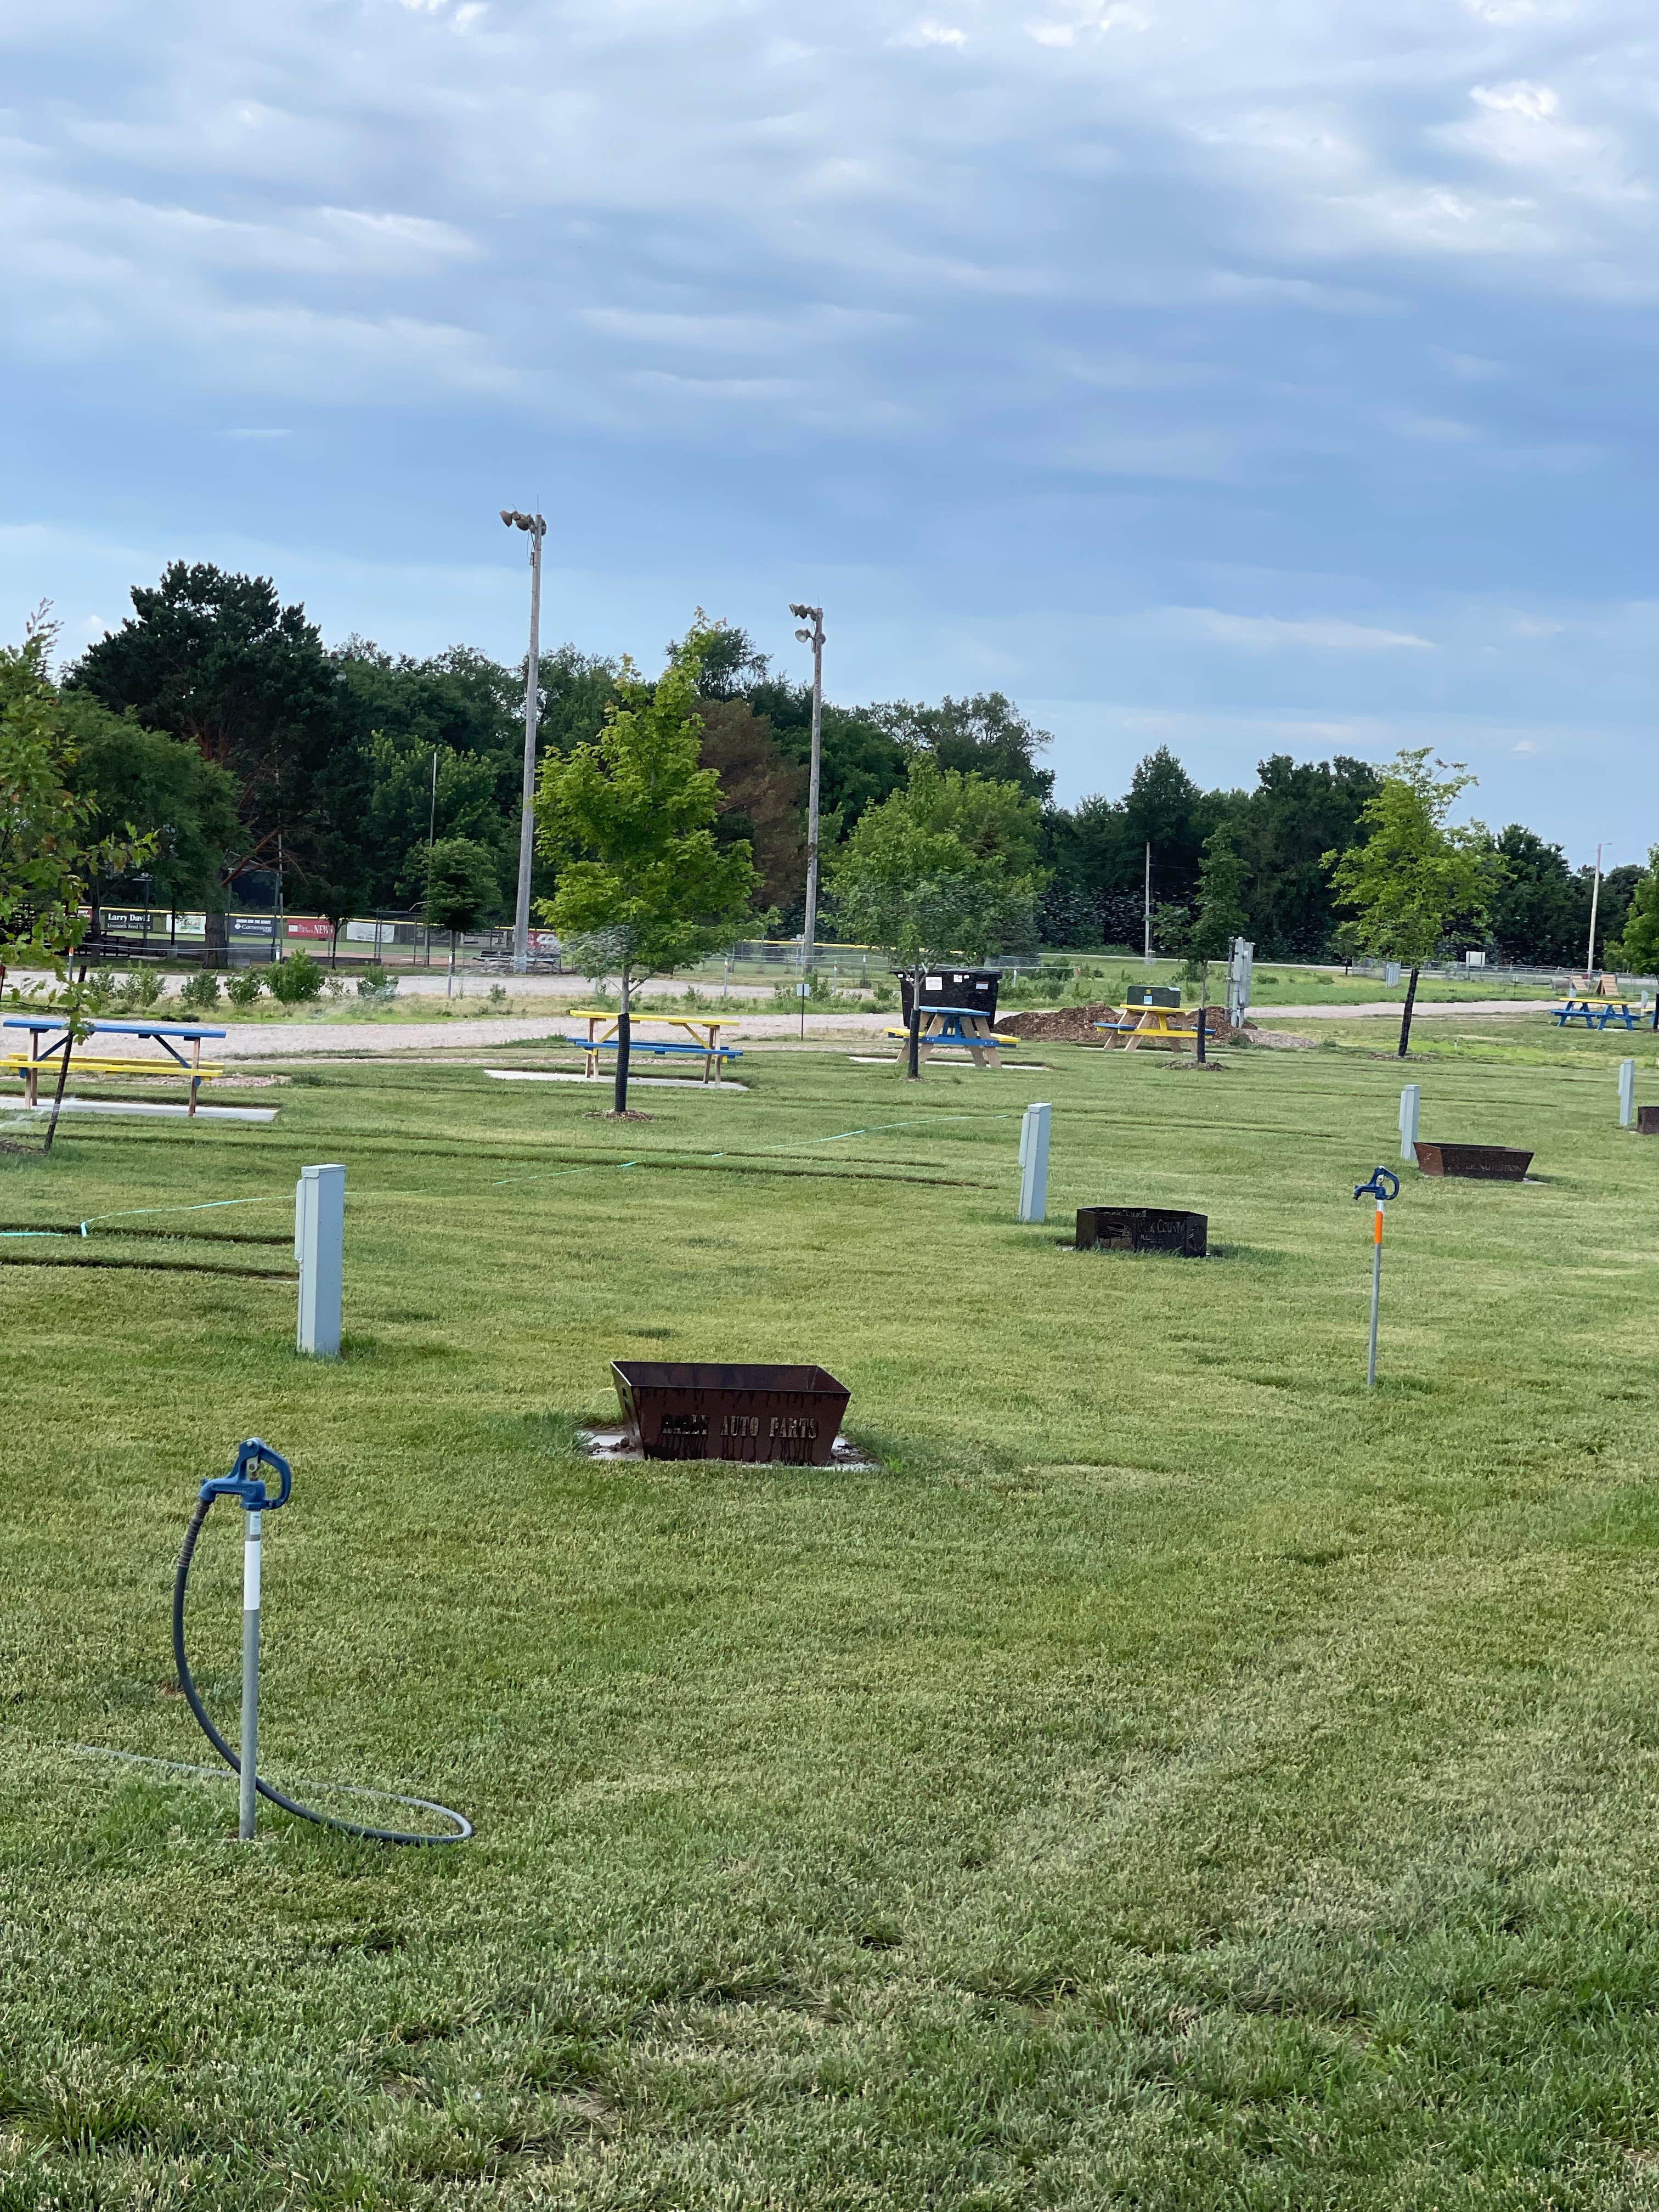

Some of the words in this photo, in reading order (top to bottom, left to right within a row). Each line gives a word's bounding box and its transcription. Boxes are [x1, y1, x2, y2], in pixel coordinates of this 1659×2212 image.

[108, 913, 127, 922] Larry
[129, 914, 150, 922] David
[720, 1415, 759, 1436] AUTO
[769, 1417, 817, 1438] PARTS
